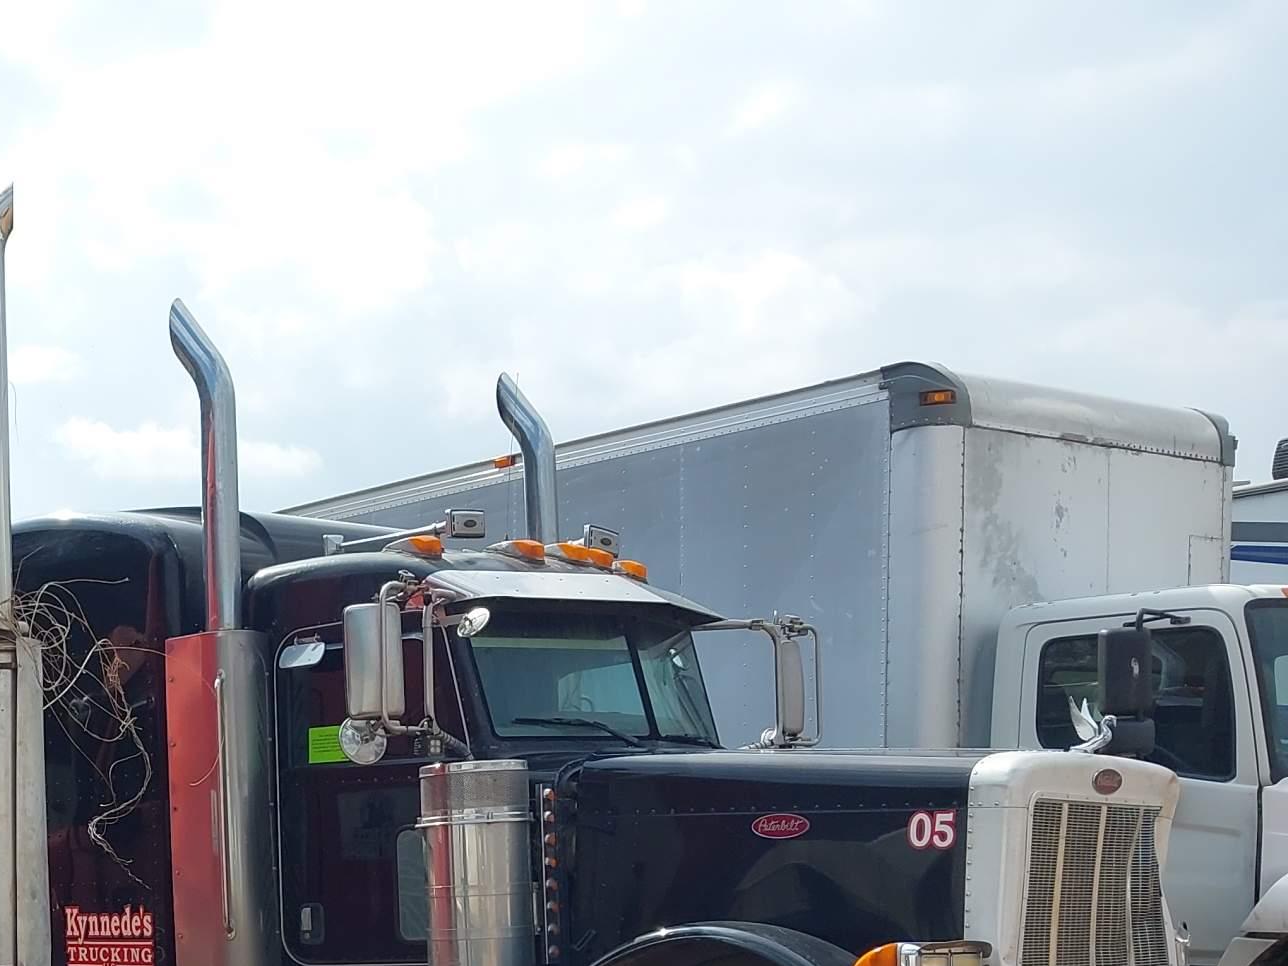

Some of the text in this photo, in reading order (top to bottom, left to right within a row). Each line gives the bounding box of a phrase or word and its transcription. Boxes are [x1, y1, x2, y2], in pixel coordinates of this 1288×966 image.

[757, 816, 802, 833] Peterbilt
[909, 812, 955, 848] 05
[65, 904, 152, 943] Kynnede's
[67, 946, 153, 963] TRUCKING
